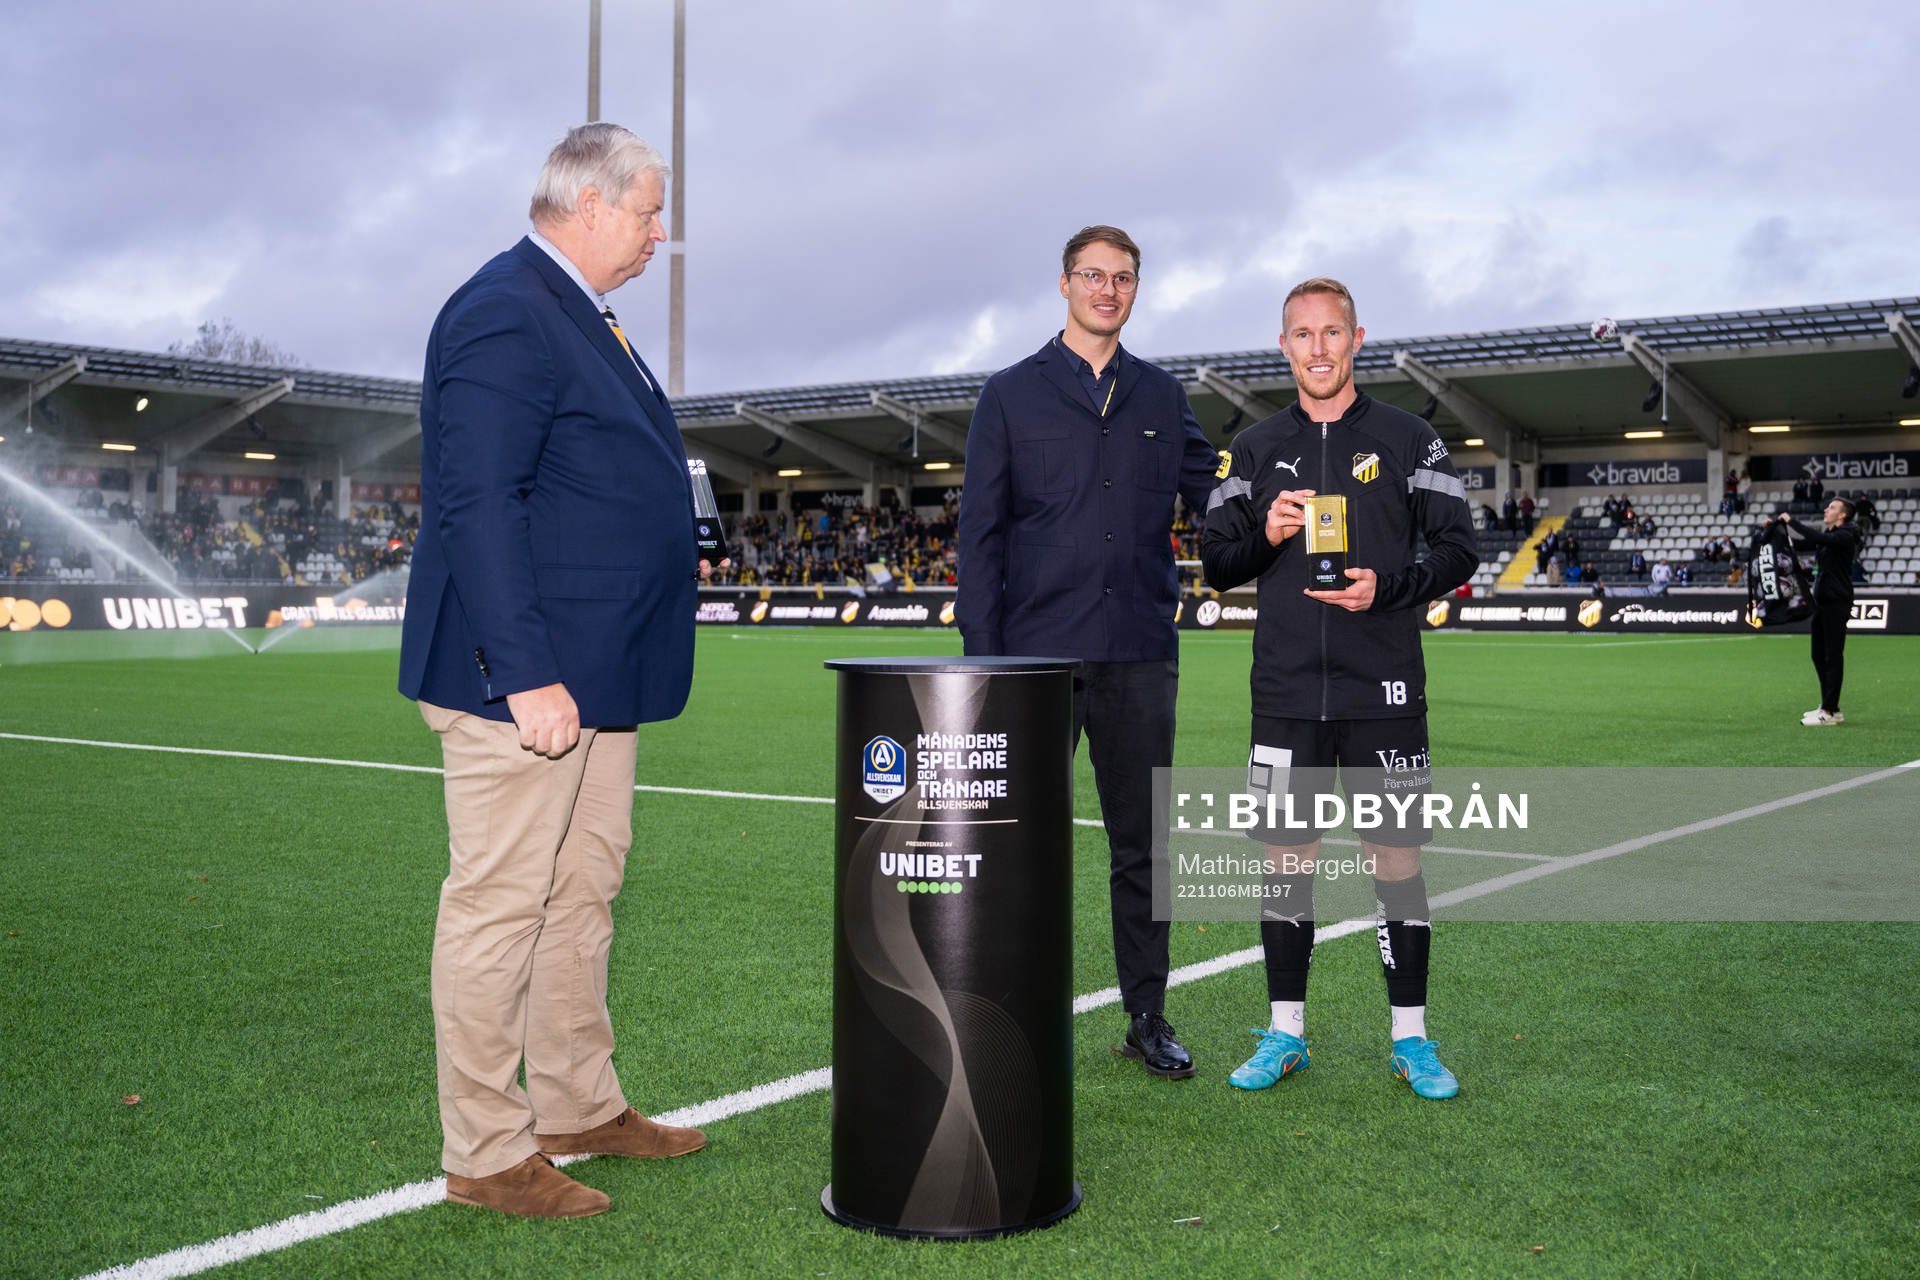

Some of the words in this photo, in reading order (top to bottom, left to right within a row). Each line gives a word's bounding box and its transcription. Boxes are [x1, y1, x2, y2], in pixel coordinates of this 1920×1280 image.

[1607, 461, 1680, 484] bravida
[1825, 454, 1908, 478] bravida
[1759, 543, 1779, 600] SELECT
[103, 597, 248, 629] UNIBET
[868, 604, 929, 621] Assemblin
[1381, 681, 1407, 705] 18
[917, 731, 1008, 749] MÅNADENS
[917, 751, 1008, 769] SPELARE
[866, 772, 902, 783] ALLSVENSKAN
[917, 770, 937, 780] OCH
[917, 778, 1008, 798] TRÄNARE
[917, 800, 989, 810] ALLSVENSKAN
[905, 840, 944, 848] PRESENTERAS
[880, 852, 982, 878] UNIBET
